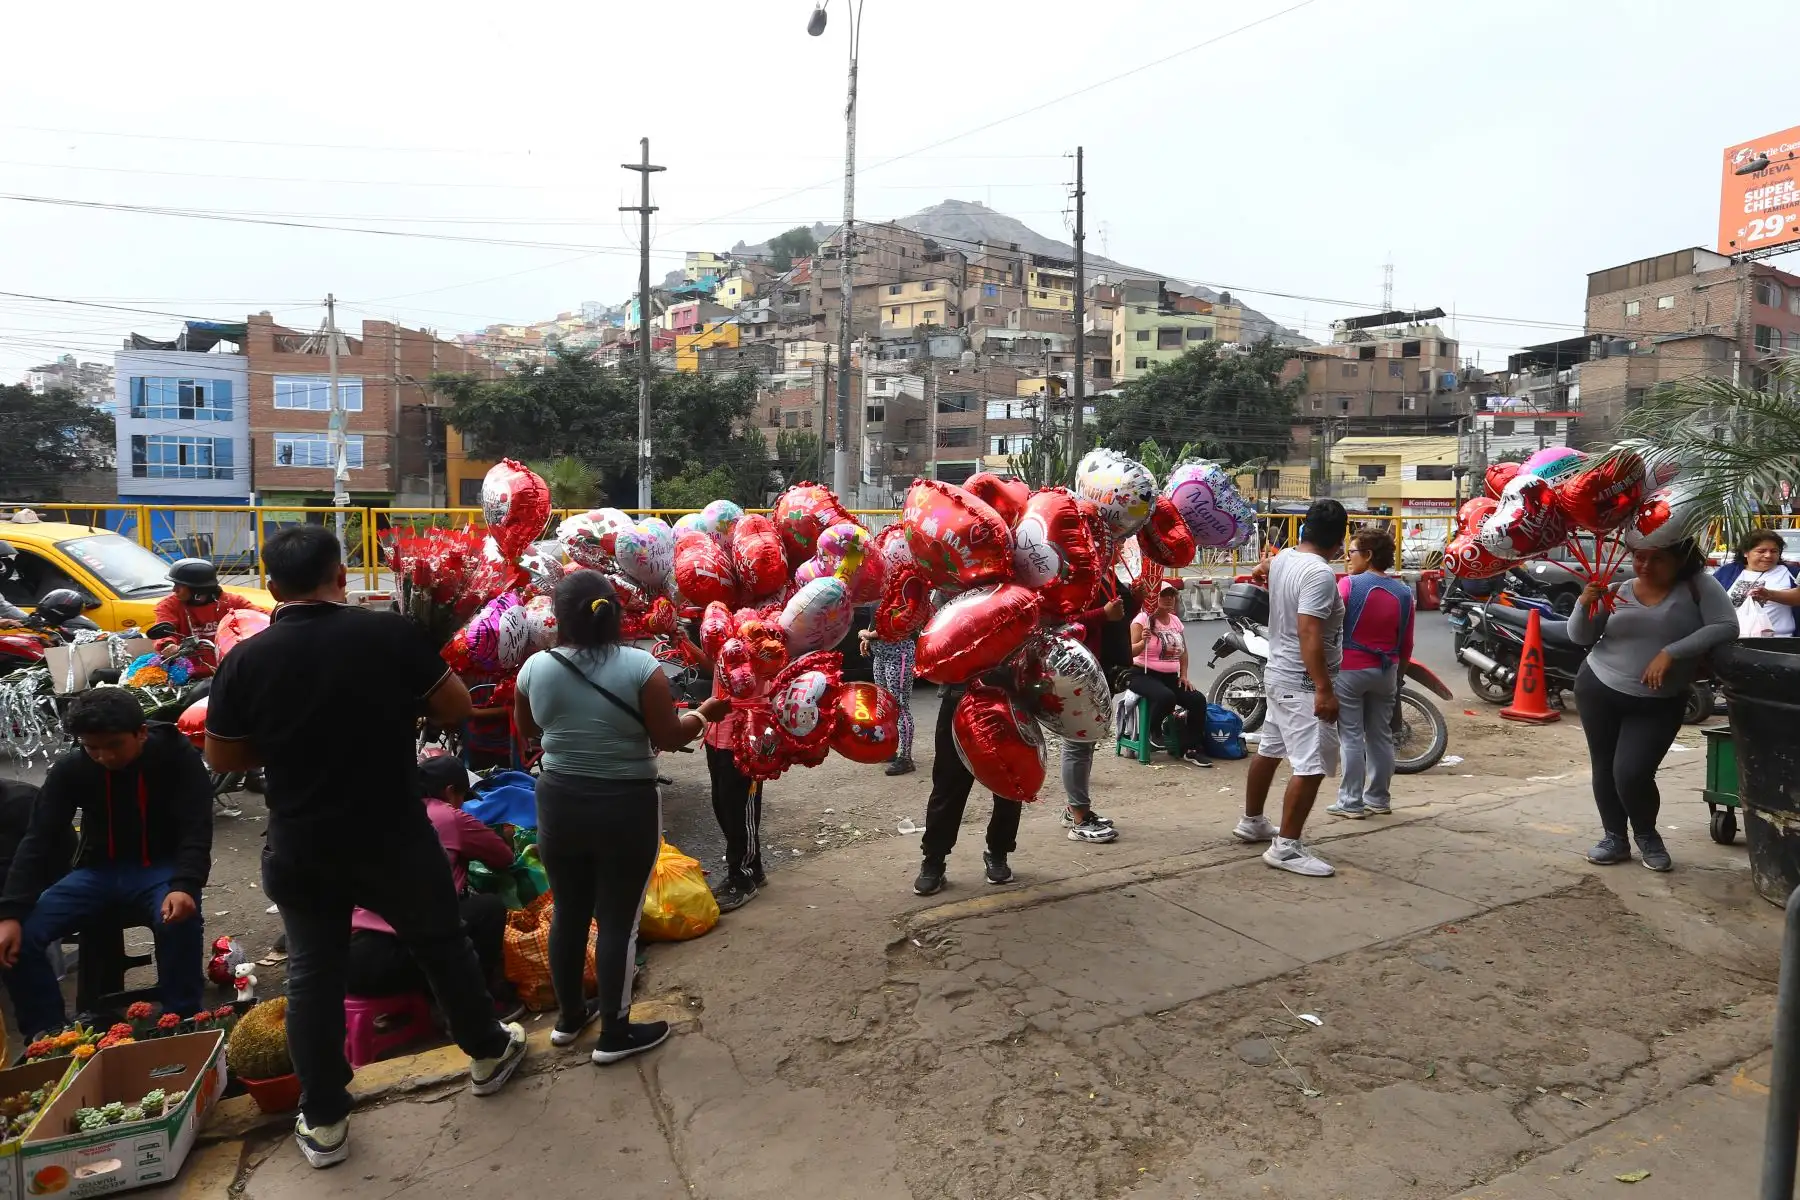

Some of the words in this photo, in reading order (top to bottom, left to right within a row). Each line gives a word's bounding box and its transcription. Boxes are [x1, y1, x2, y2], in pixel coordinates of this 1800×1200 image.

[1752, 163, 1791, 179] NUEVA
[1744, 180, 1795, 201] SUPER
[1744, 190, 1800, 214] CHEESE
[1186, 488, 1229, 535] Mamá
[1408, 499, 1450, 507] Kantifarma
[1523, 647, 1542, 693] ATU
